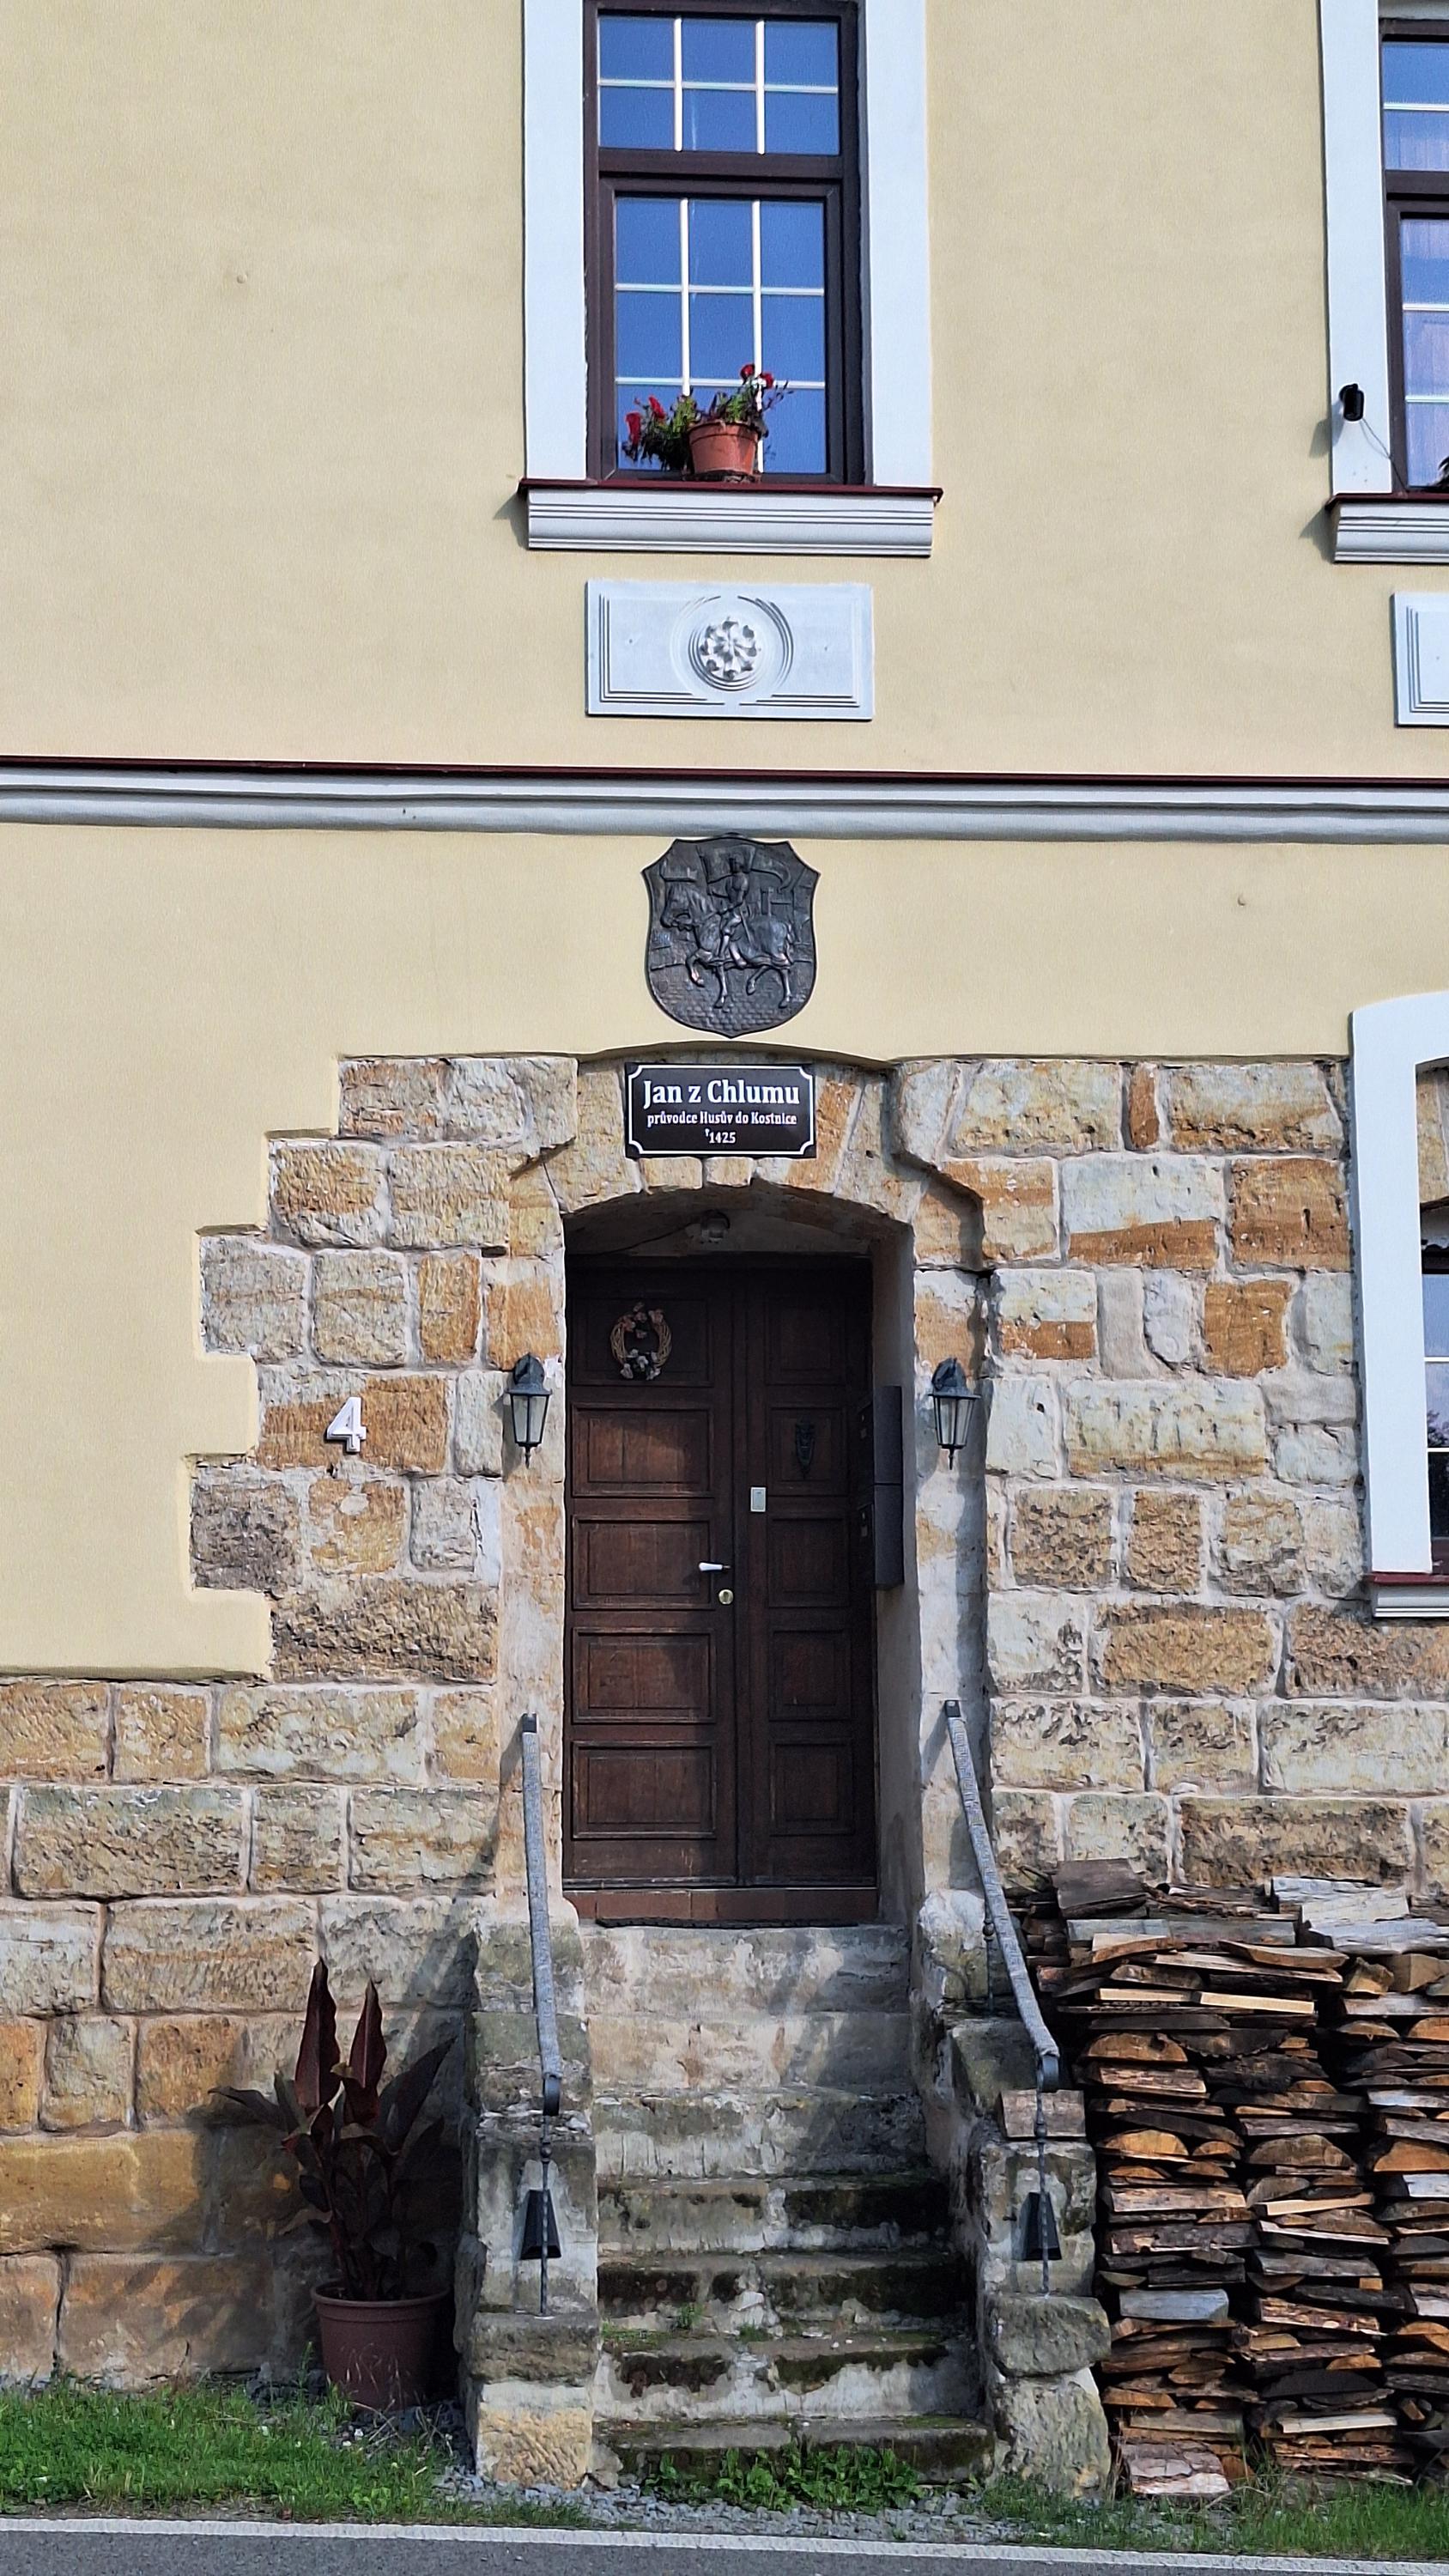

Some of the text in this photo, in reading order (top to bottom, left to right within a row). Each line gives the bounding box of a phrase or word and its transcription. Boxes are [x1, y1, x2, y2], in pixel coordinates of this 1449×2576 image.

[643, 1078, 800, 1109] Jan z Chlumu
[646, 1111, 797, 1128] průvodce Husův do Kostnice
[326, 1396, 367, 1452] 4
